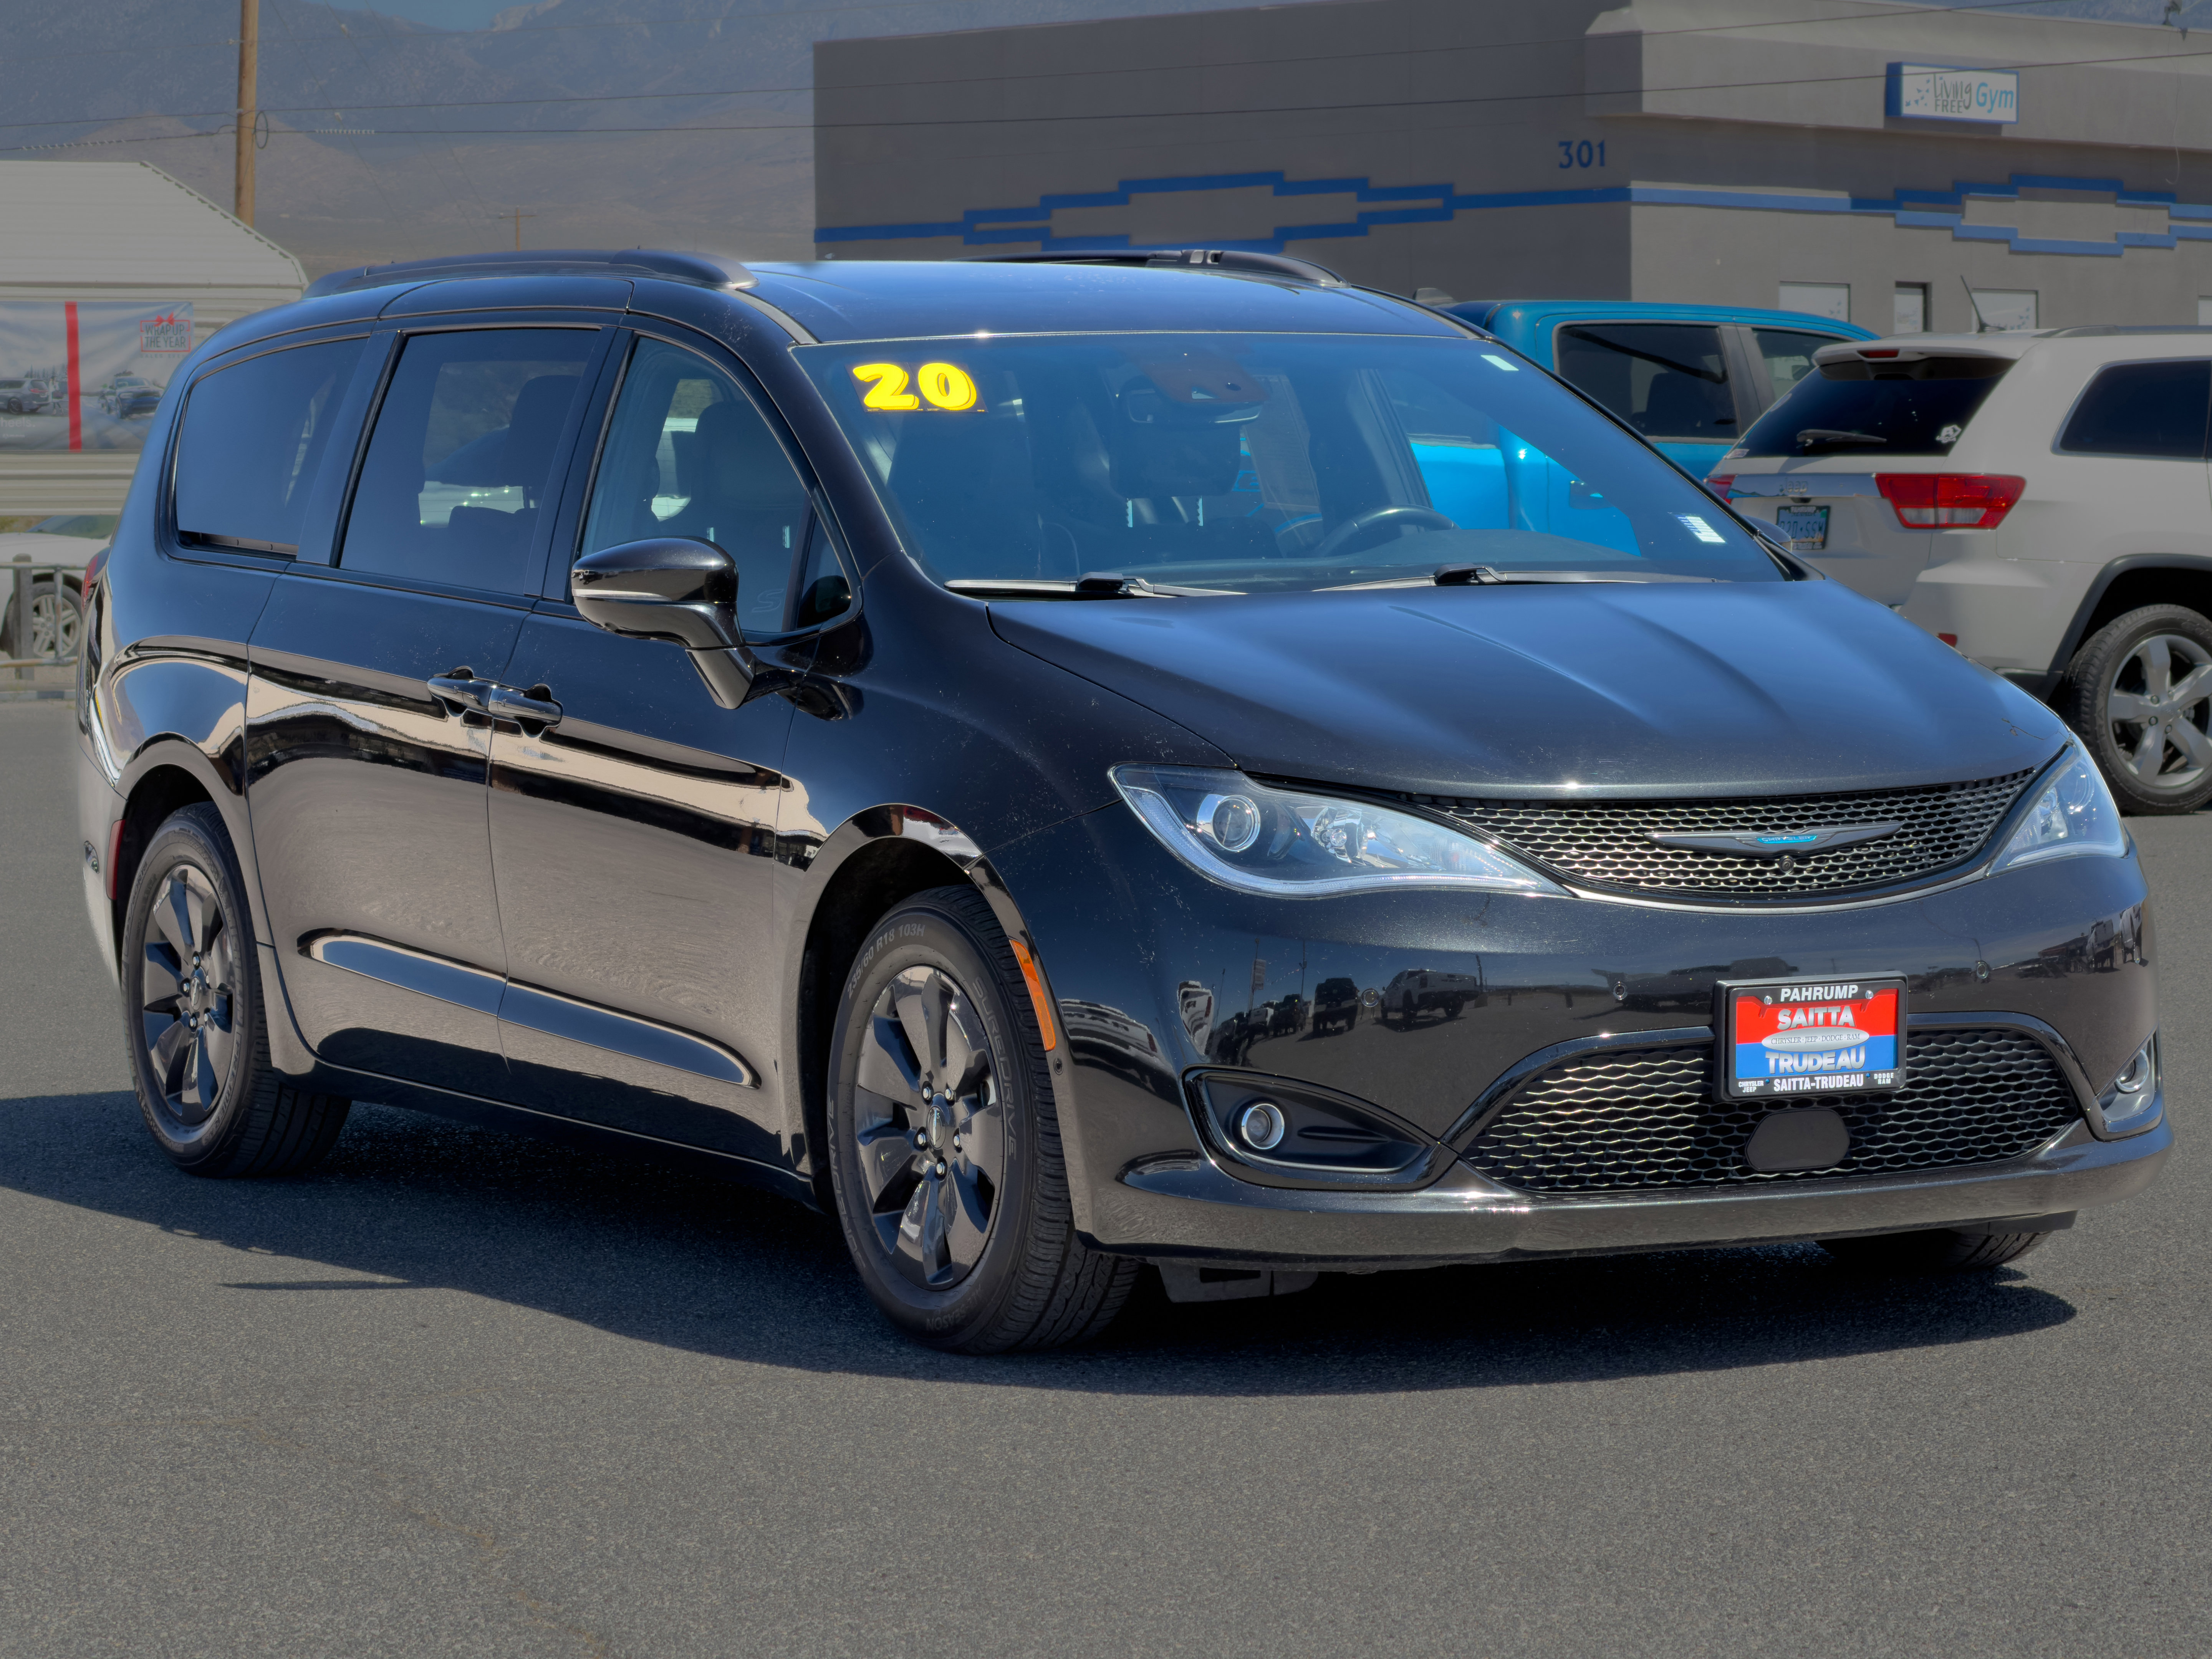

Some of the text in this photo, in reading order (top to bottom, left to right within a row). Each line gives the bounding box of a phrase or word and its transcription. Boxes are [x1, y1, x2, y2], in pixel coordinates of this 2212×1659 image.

[1934, 98, 1963, 113] FREE
[1976, 82, 2014, 113] Gym
[1558, 139, 1605, 169] 301
[145, 324, 185, 336] WRAP UP
[145, 336, 186, 348] THE YEAR
[853, 363, 977, 411] 20
[0, 417, 36, 427] heels.
[1779, 477, 1808, 496] Jeep
[848, 923, 926, 1000] 235/60 R18 103H
[1780, 985, 1858, 1002] PAHRUMP
[1777, 1005, 1856, 1030] SAITTA
[1805, 1035, 1818, 1044] JEEP
[1765, 1046, 1865, 1074] TRUDEAU
[1774, 1074, 1864, 1092] SAITTA-TRUDEAU
